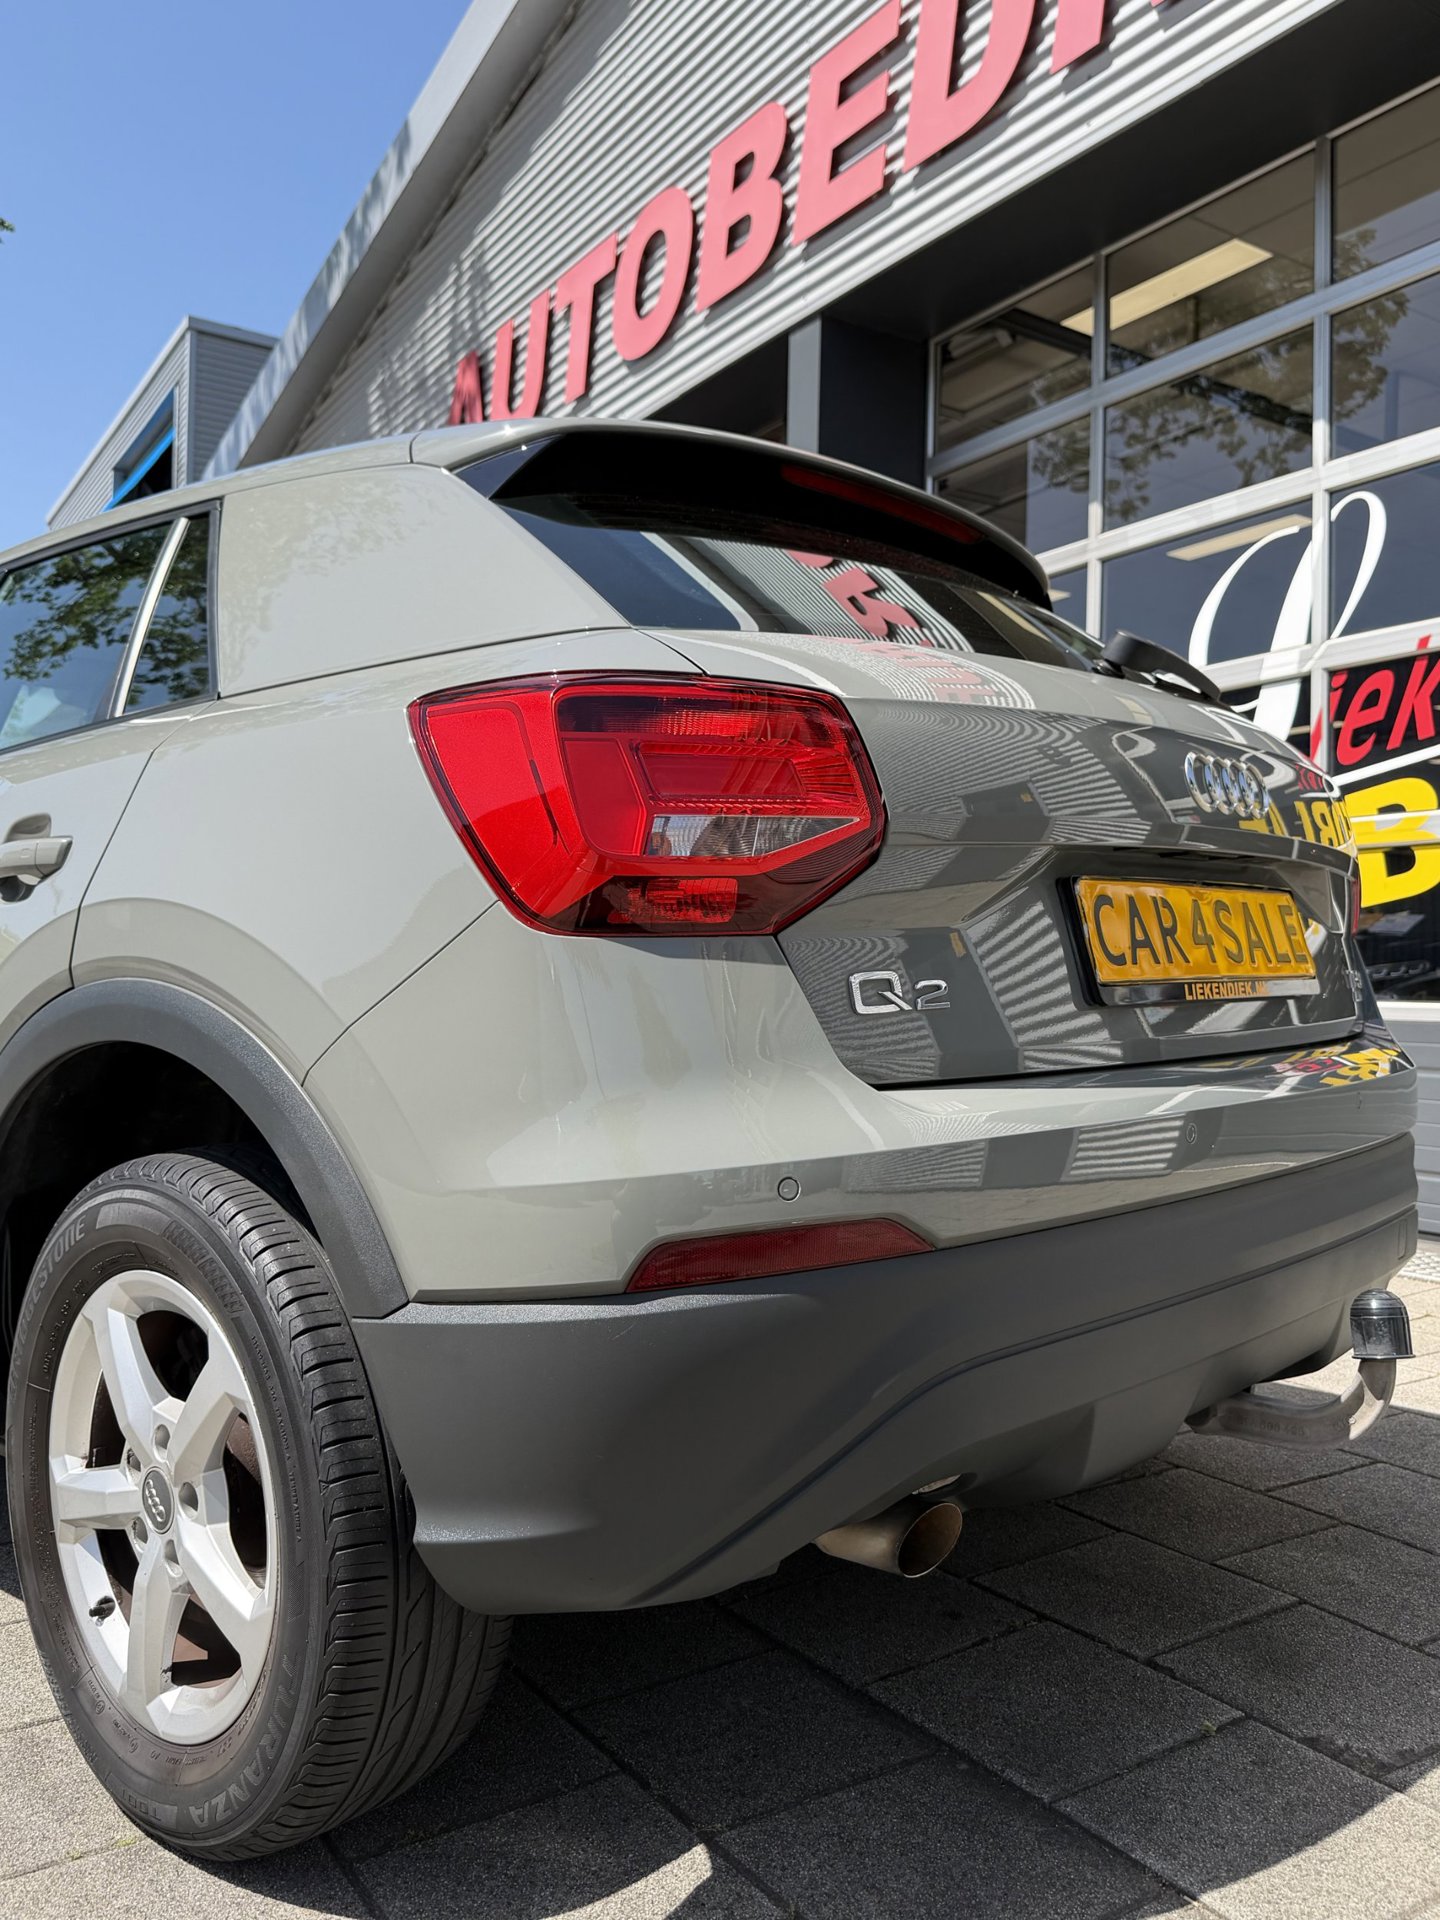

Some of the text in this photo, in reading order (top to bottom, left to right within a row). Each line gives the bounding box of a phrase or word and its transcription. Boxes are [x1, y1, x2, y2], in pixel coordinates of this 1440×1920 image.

[448, 0, 1166, 425] AUTOBED
[1094, 894, 1191, 967] CAR
[849, 970, 951, 1015] Q2
